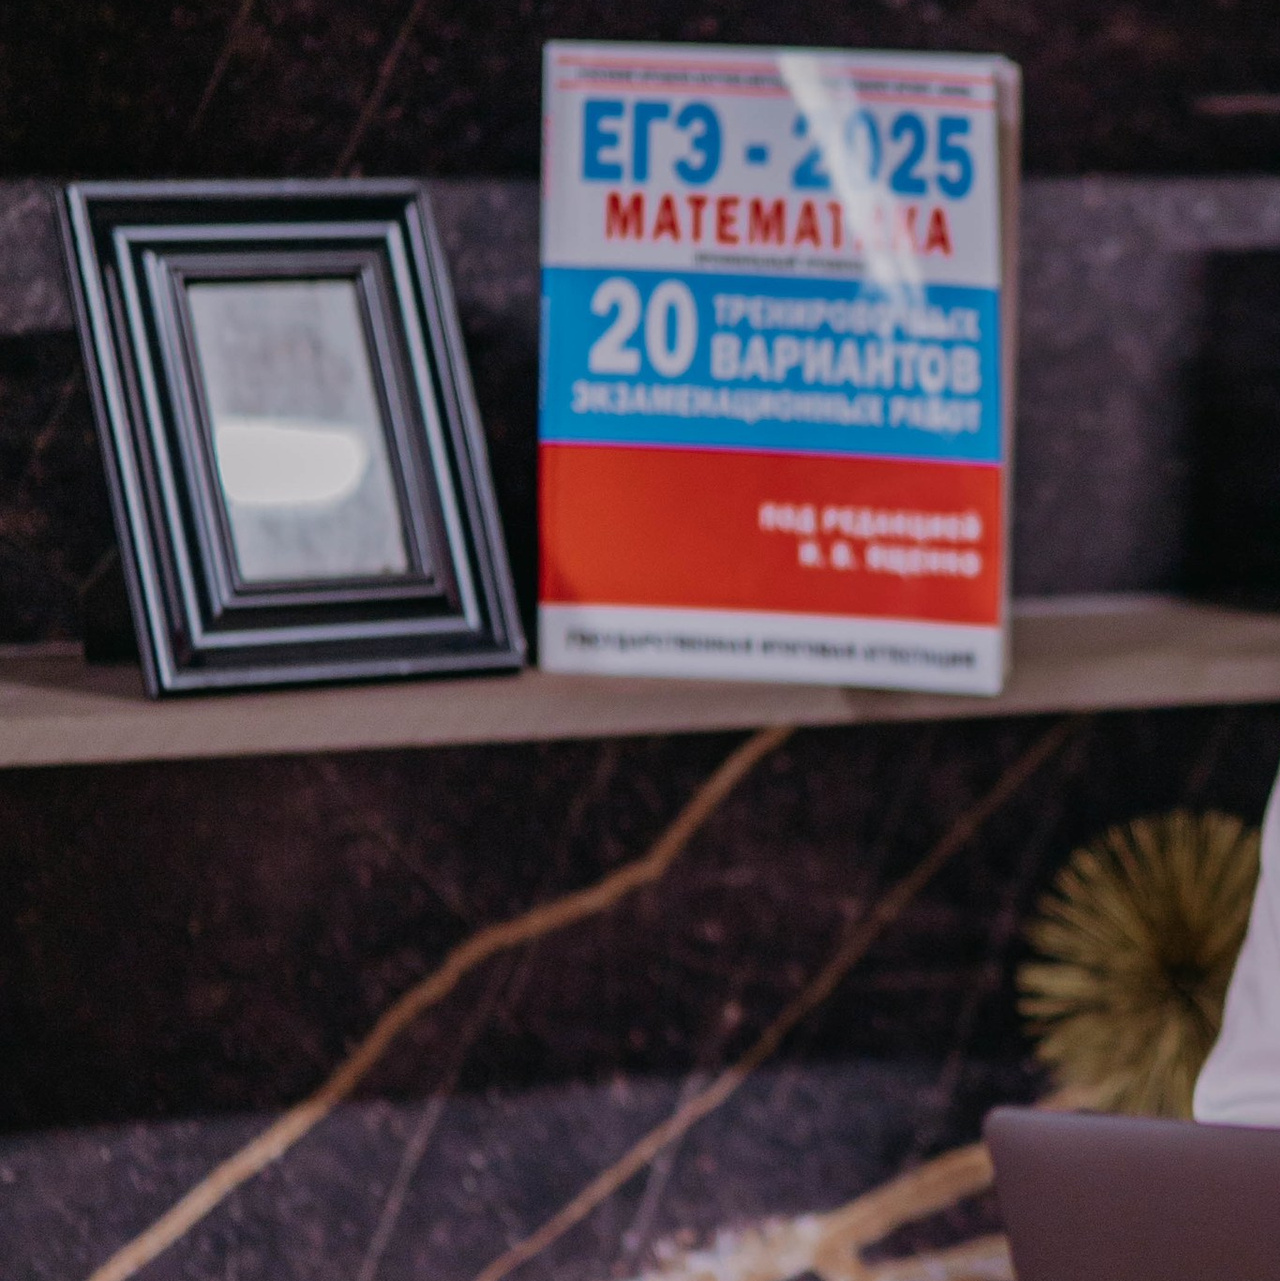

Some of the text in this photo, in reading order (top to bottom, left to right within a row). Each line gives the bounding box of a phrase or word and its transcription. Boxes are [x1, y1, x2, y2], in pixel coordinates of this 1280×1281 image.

[582, 98, 722, 186] ЕГЭ
[792, 107, 974, 200] 2025
[605, 190, 954, 259] МАТЕМАТКА
[588, 277, 698, 377] 20
[713, 293, 981, 341] ТРЕНИРОВОЧНЫХ
[709, 332, 981, 395] ВАРИАНТОВ
[571, 379, 981, 435] ЭКЗАМЕНАЦИОННЫХ РАБОТ
